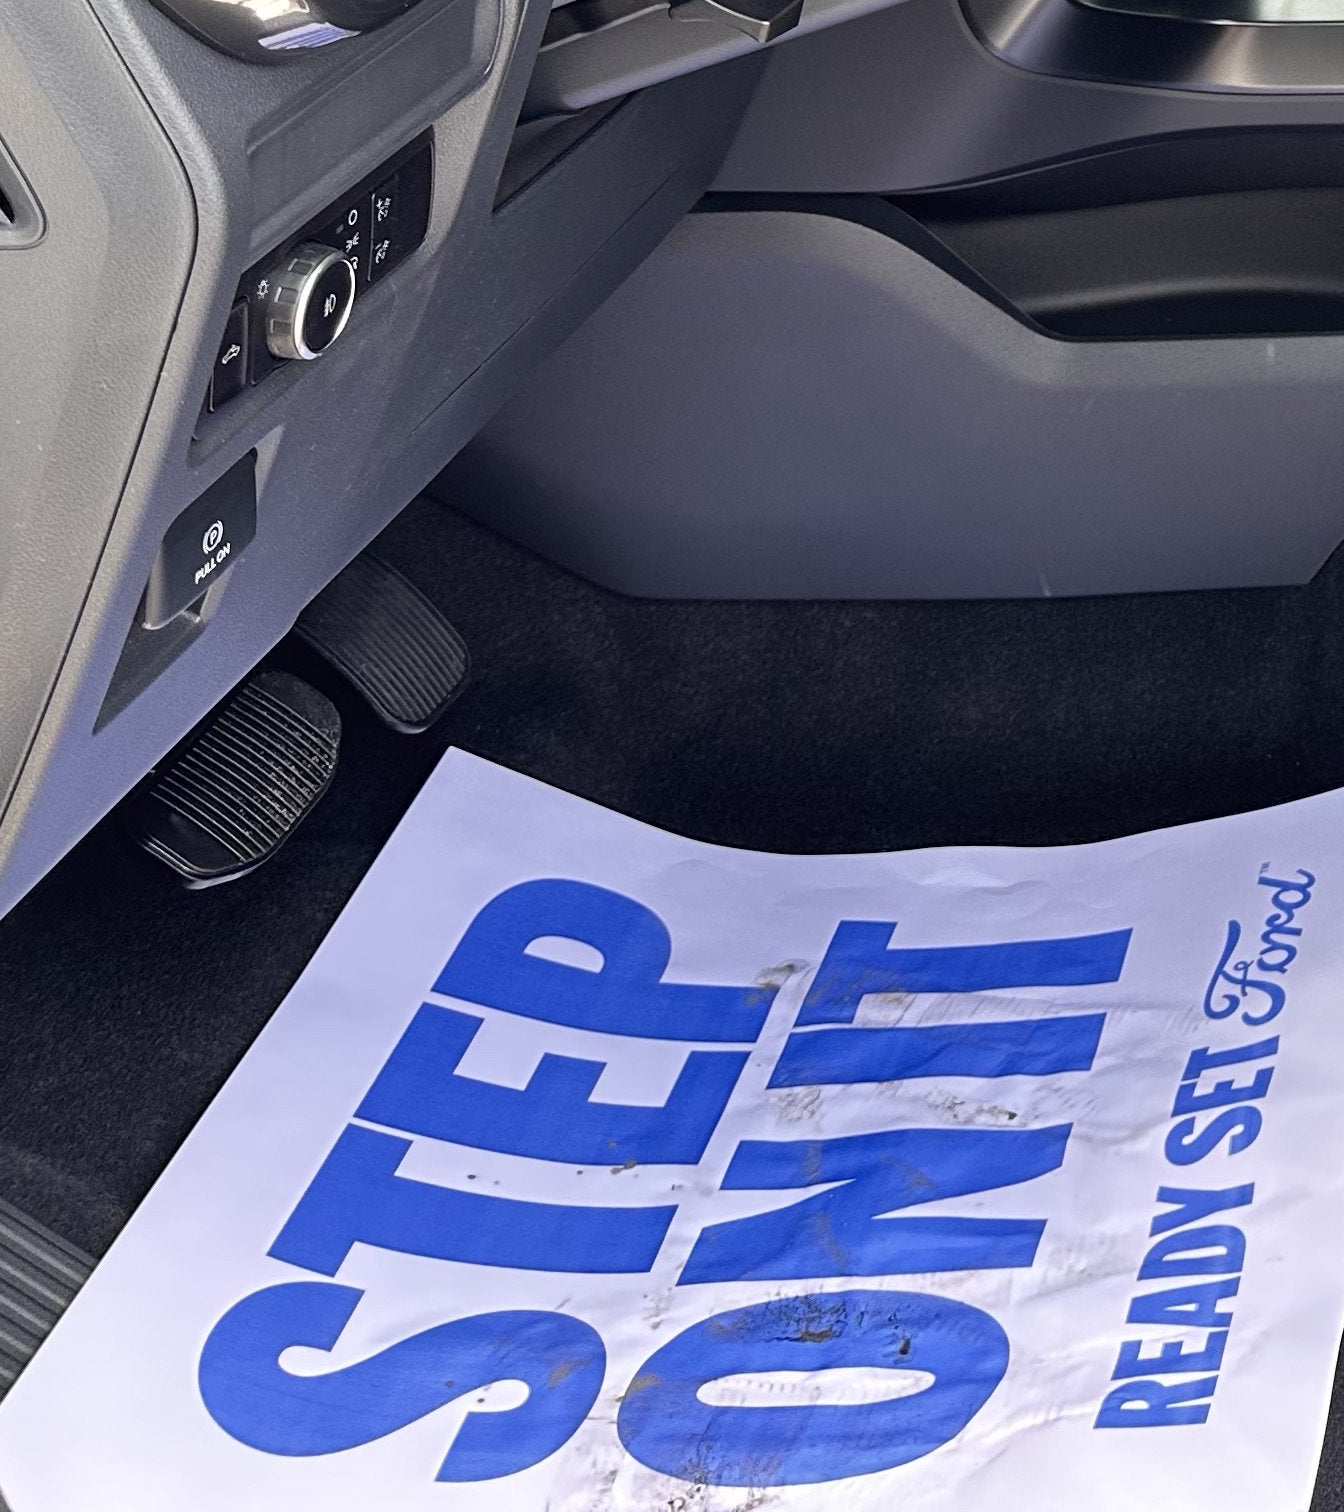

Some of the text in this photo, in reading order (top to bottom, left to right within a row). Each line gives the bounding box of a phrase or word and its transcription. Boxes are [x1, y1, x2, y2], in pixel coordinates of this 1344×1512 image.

[195, 542, 231, 584] PULL ON
[199, 879, 776, 1482] STEP
[618, 920, 1133, 1486] ON IT
[1094, 867, 1316, 1429] READY SET Ford
